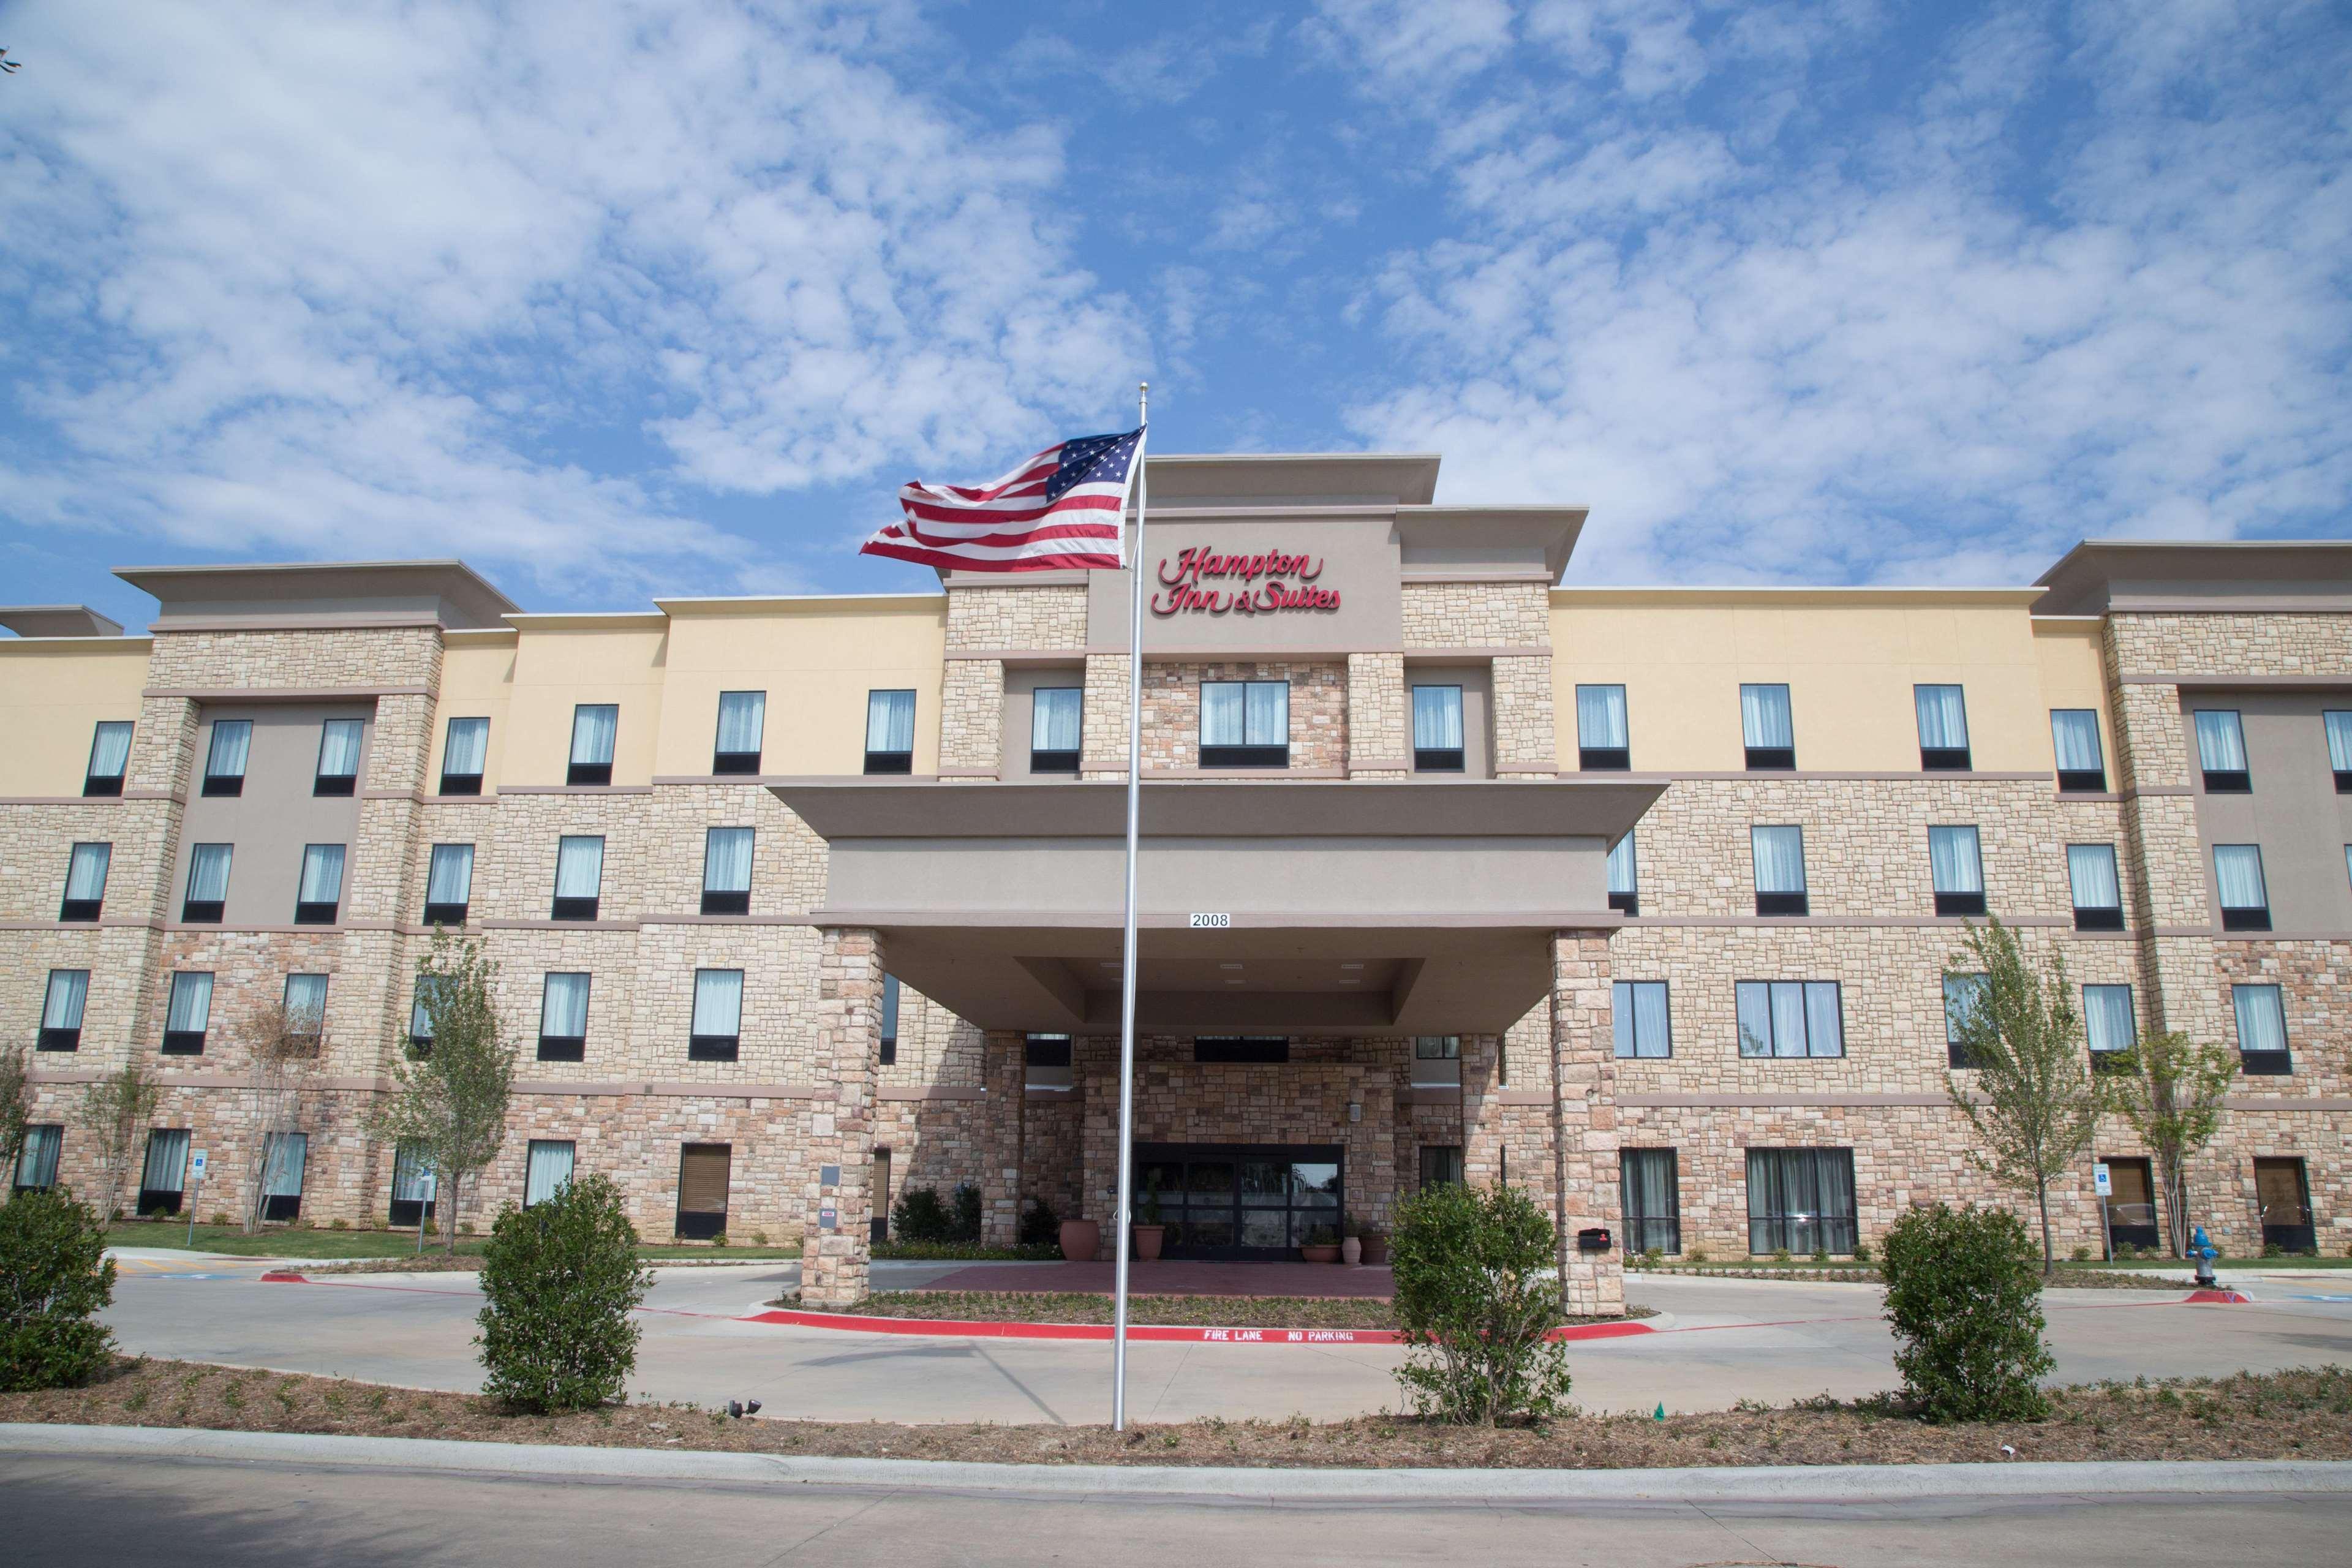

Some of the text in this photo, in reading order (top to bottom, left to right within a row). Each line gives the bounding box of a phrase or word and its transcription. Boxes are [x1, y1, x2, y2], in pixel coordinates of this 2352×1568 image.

[1158, 546, 1324, 584] Hampton
[1151, 581, 1341, 613] Inn & Suites
[1193, 914, 1228, 926] 2008
[1204, 1329, 1354, 1341] FIRE LANE NO PARKING
